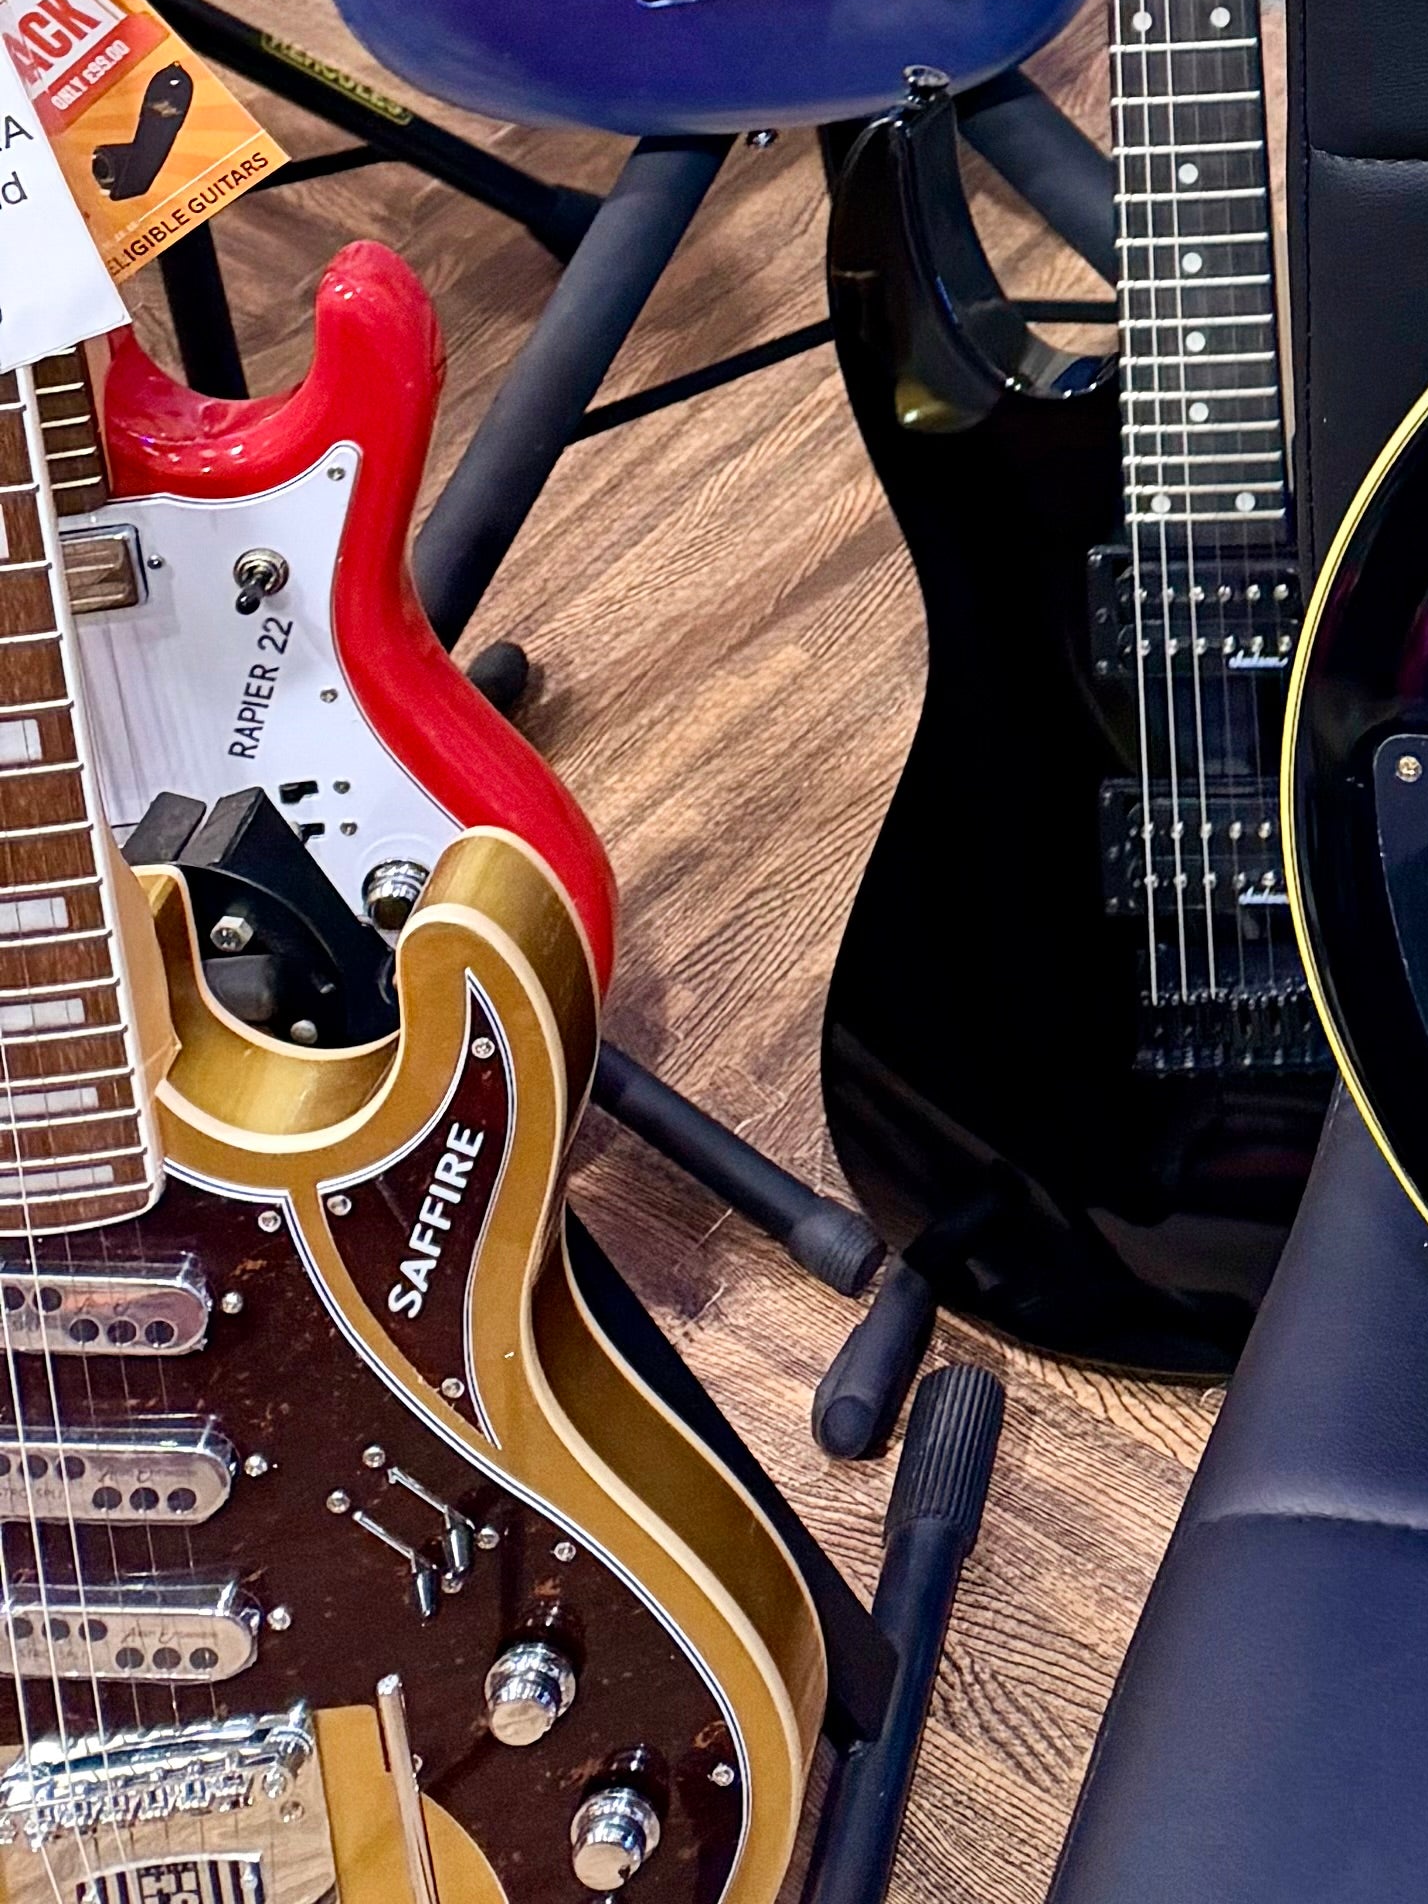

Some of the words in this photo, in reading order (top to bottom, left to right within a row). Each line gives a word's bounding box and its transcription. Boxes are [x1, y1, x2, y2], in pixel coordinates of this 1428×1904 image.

[50, 74, 90, 111] ONLY
[109, 209, 190, 277] ELIGIBLE
[187, 151, 269, 215] GUITARS
[228, 659, 280, 761] RAPIER
[257, 616, 293, 656] 22
[388, 1121, 485, 1320] SAFFIRE
